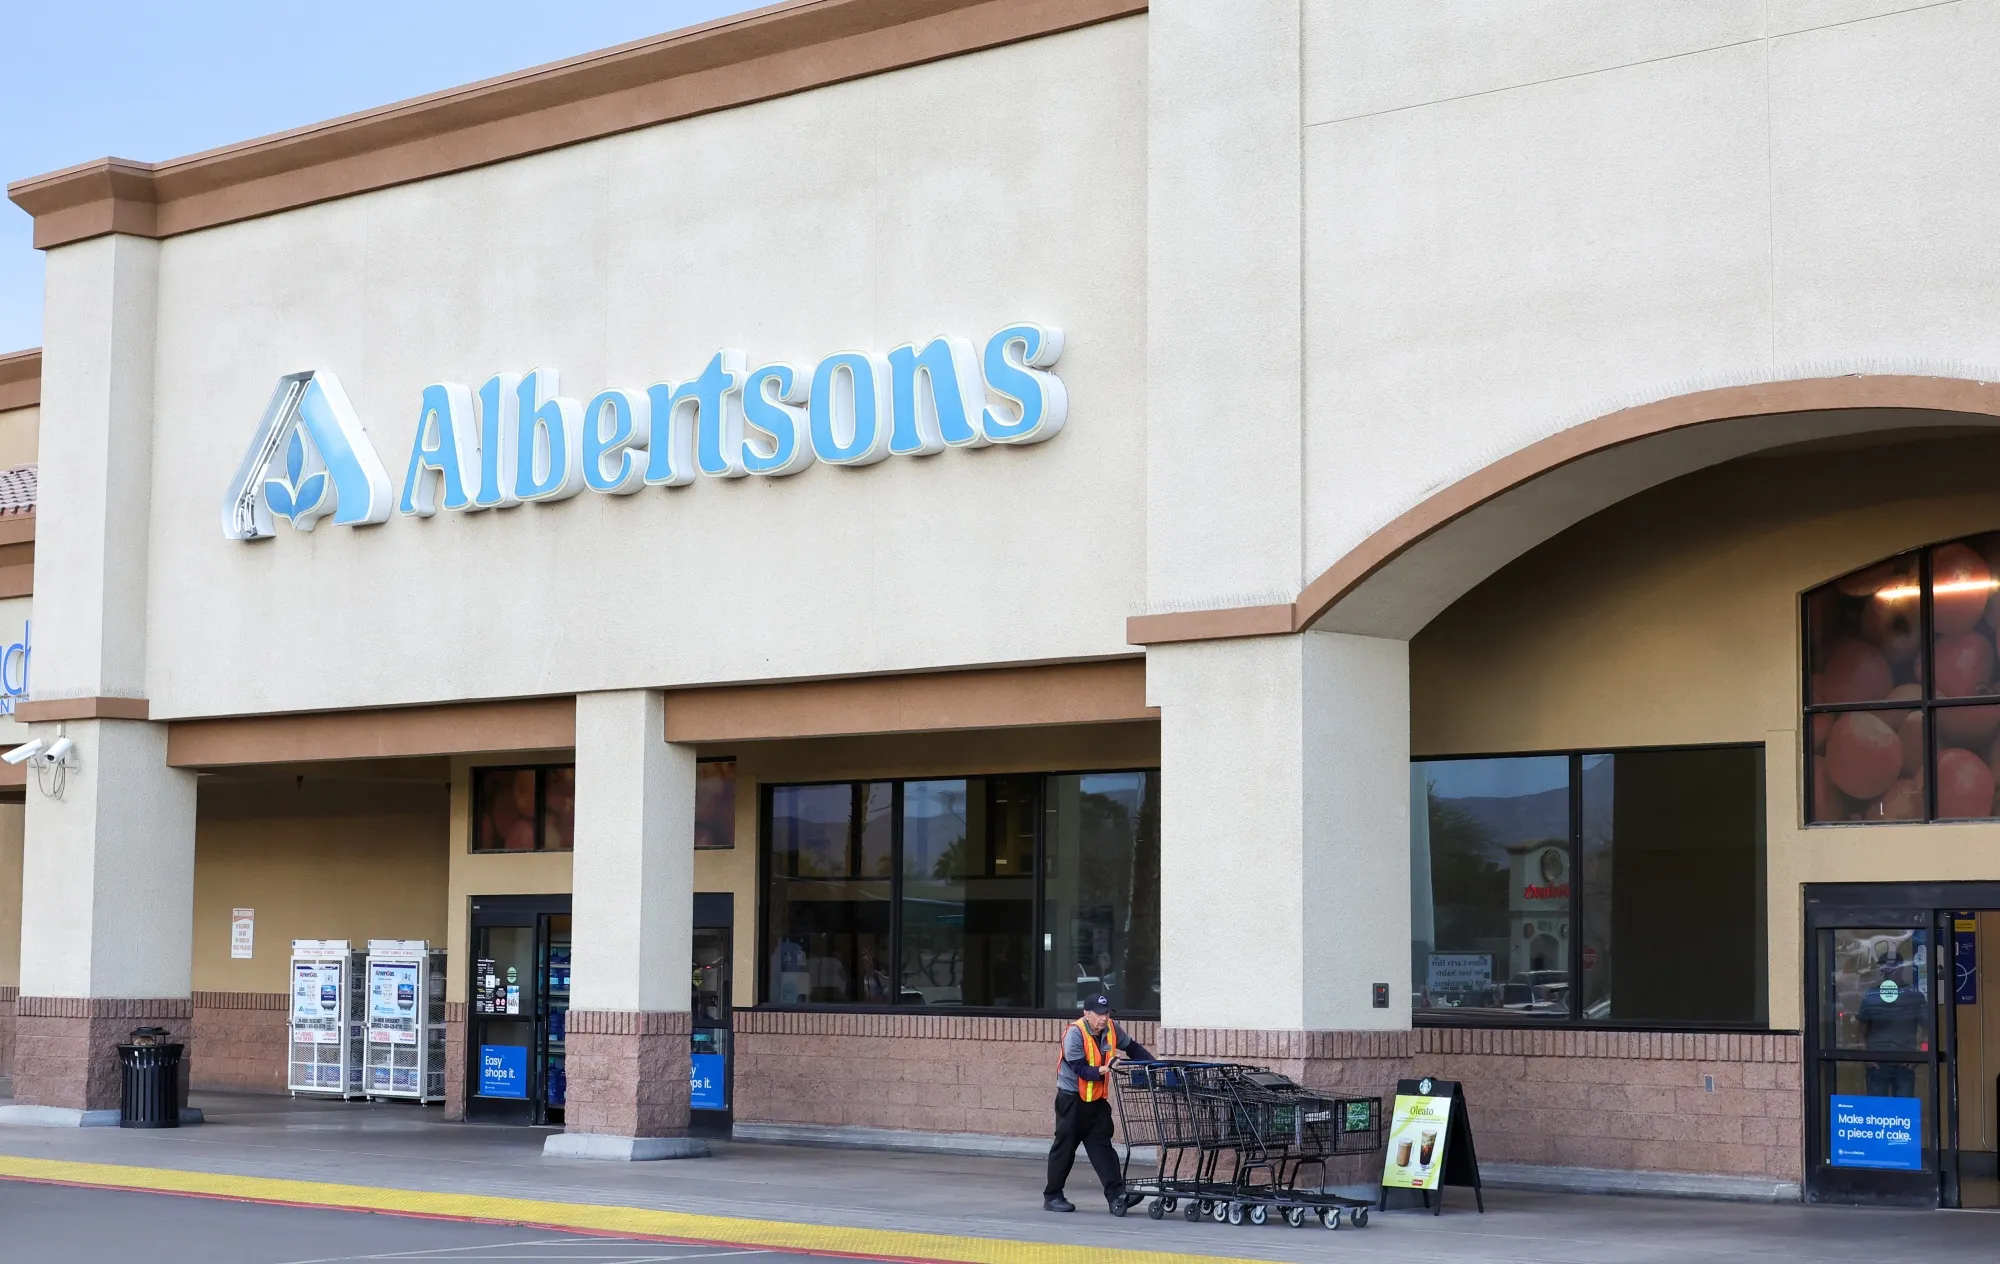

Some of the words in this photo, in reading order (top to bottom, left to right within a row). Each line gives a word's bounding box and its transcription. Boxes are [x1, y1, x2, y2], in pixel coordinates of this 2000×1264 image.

[400, 322, 1065, 516] Albertsons
[485, 1055, 503, 1069] Easy
[484, 1066, 508, 1081] shops
[508, 1067, 516, 1079] it.
[704, 1077, 712, 1089] it.
[1409, 1105, 1434, 1116] Oleato
[1838, 1113, 1864, 1124] Make
[1865, 1114, 1911, 1129] shopping
[1838, 1129, 1845, 1138] a
[1847, 1127, 1873, 1140] piece
[1875, 1128, 1885, 1139] of
[1886, 1130, 1912, 1141] cake.
